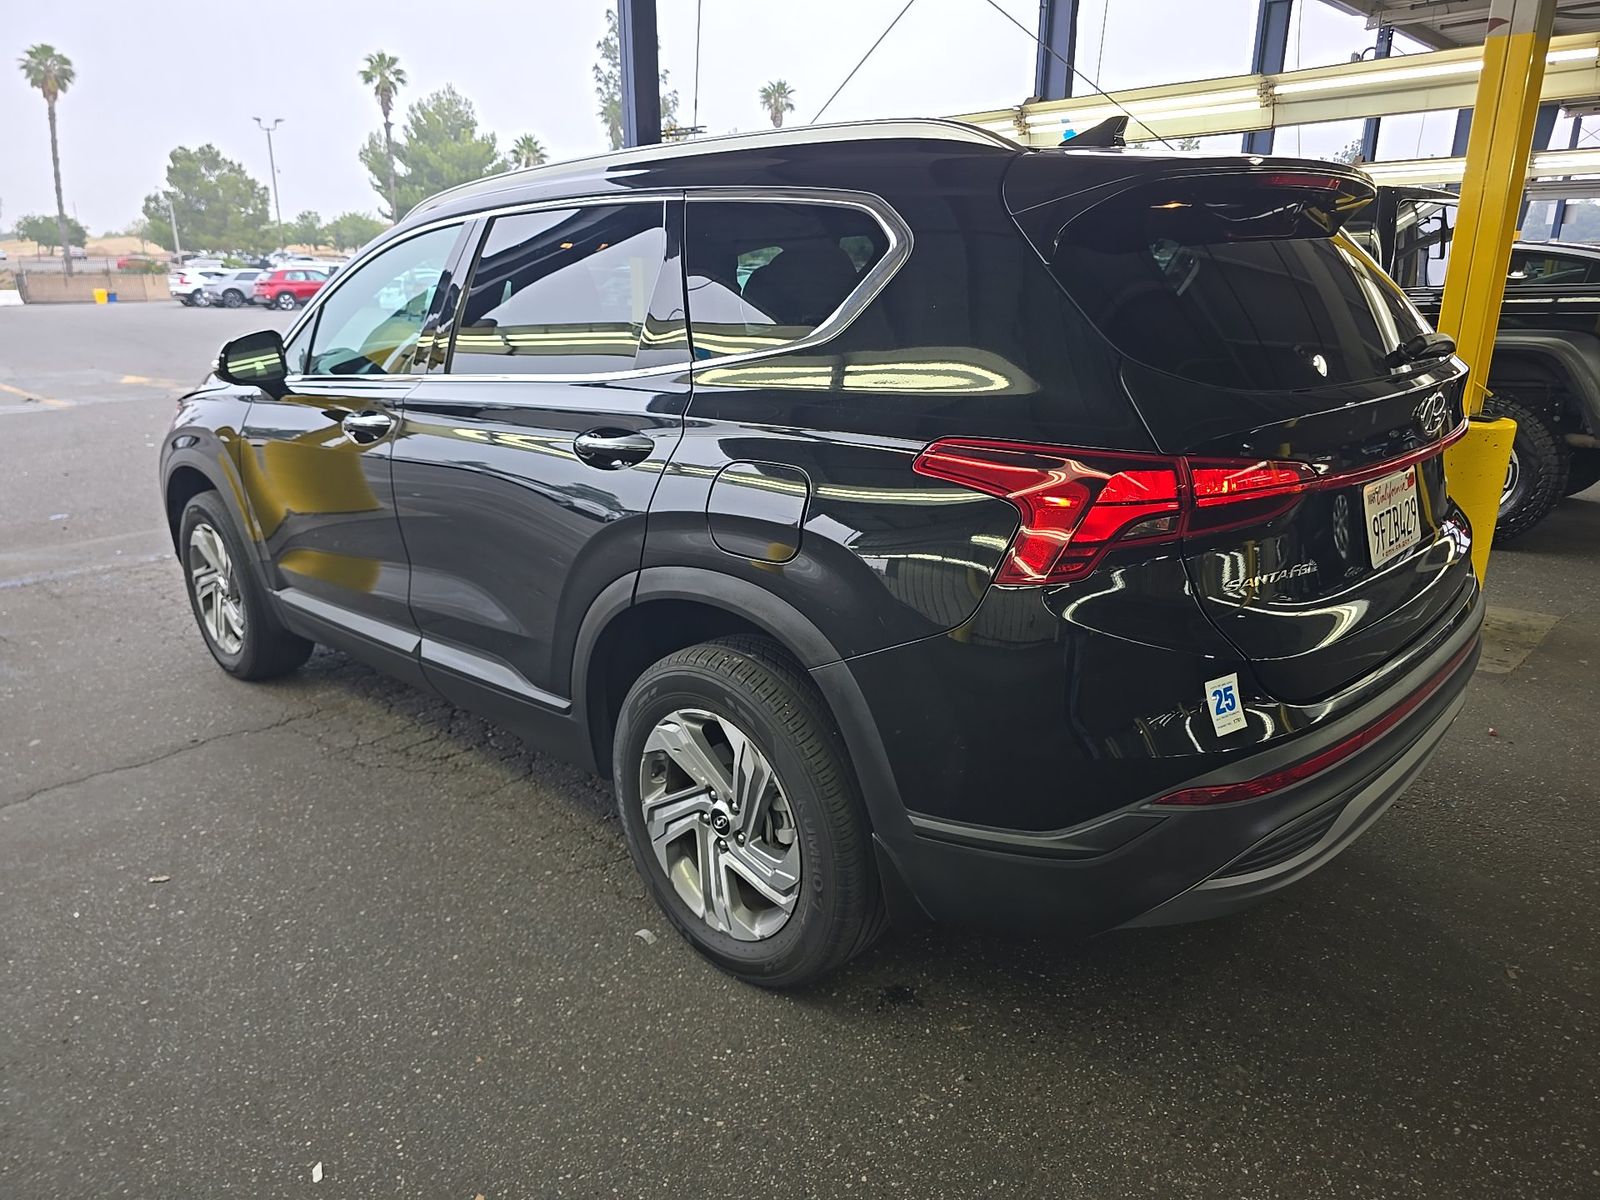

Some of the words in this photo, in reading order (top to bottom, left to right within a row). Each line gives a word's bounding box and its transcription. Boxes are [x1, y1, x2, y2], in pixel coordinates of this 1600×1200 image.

[1376, 480, 1408, 505] California
[1372, 496, 1416, 555] 9FZB429
[1212, 685, 1236, 715] 25
